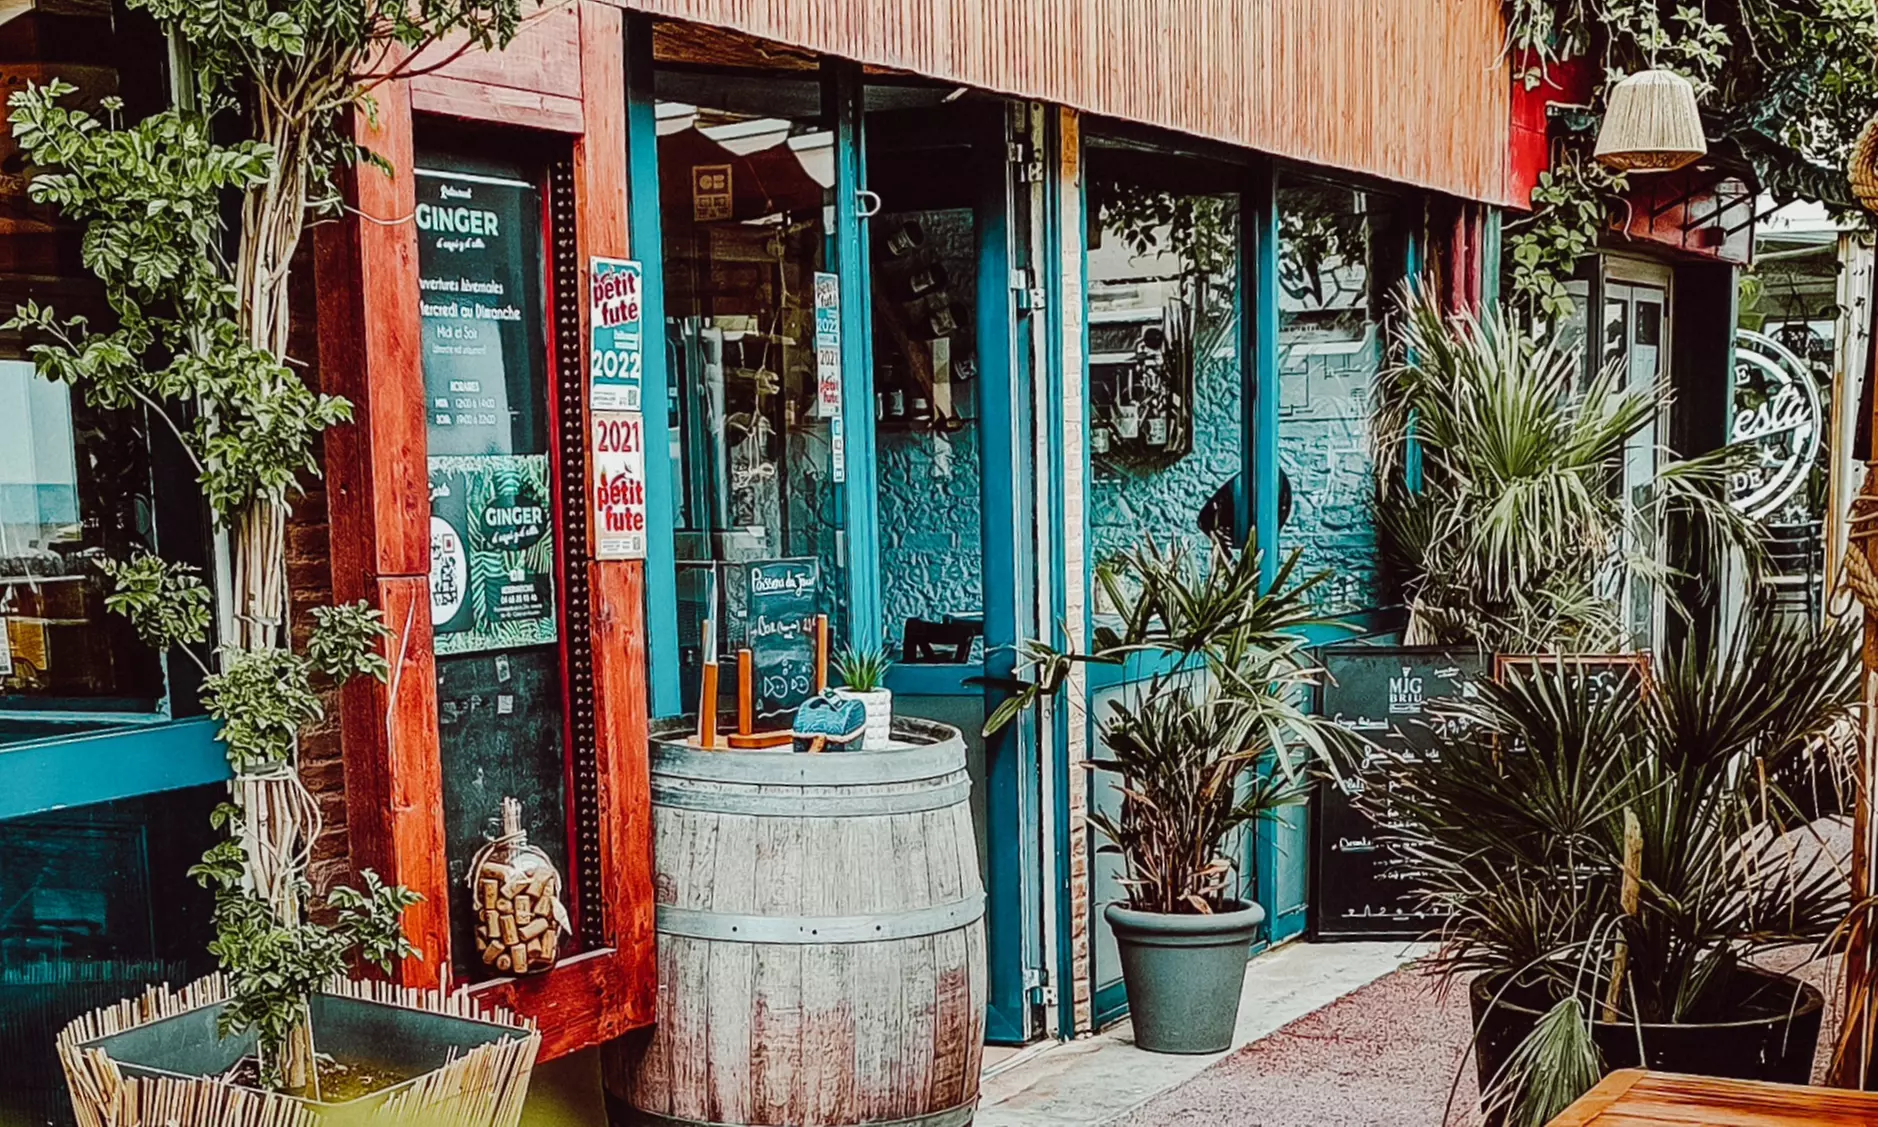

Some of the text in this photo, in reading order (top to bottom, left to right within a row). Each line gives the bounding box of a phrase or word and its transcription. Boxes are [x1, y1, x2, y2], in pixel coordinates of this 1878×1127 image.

[415, 203, 499, 236] GINGER
[593, 271, 636, 309] petit
[461, 306, 473, 319] au
[475, 303, 521, 320] Dimanche
[594, 350, 640, 379] 2022
[1732, 383, 1812, 437] esta
[597, 420, 640, 453] 2021
[597, 476, 643, 512] petit
[485, 506, 543, 526] GINGER
